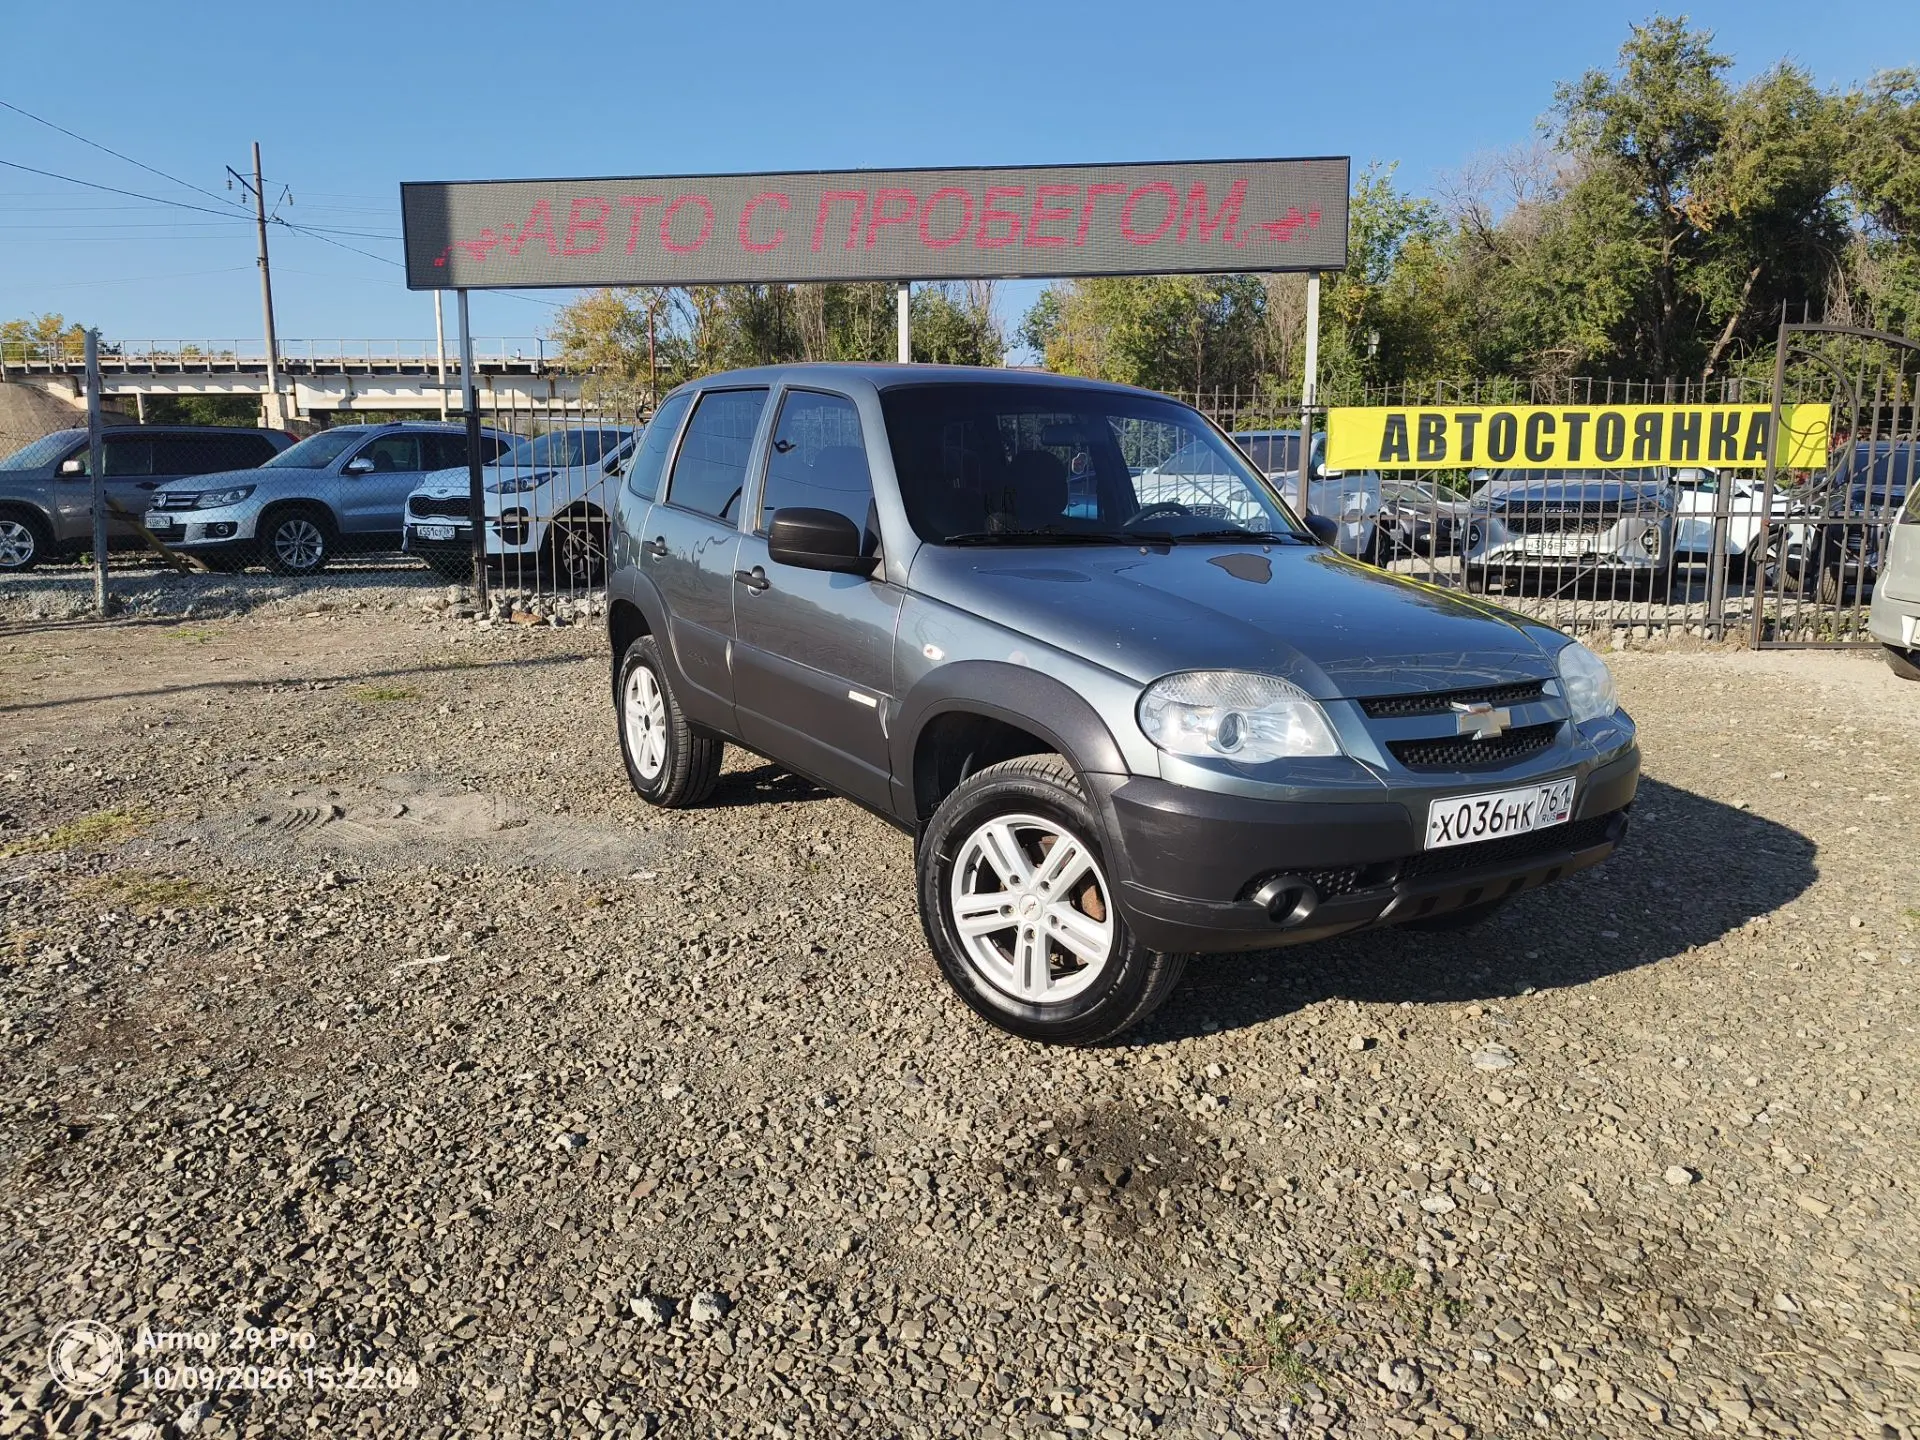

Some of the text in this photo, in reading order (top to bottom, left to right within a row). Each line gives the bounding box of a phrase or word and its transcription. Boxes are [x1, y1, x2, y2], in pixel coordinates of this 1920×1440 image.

[509, 178, 1249, 257] АВТО С ПРОБЕГОМ
[1378, 410, 1769, 463] АВТОСТОЯНКА
[1436, 784, 1570, 843] Х036НК 761
[1541, 811, 1557, 823] RUS
